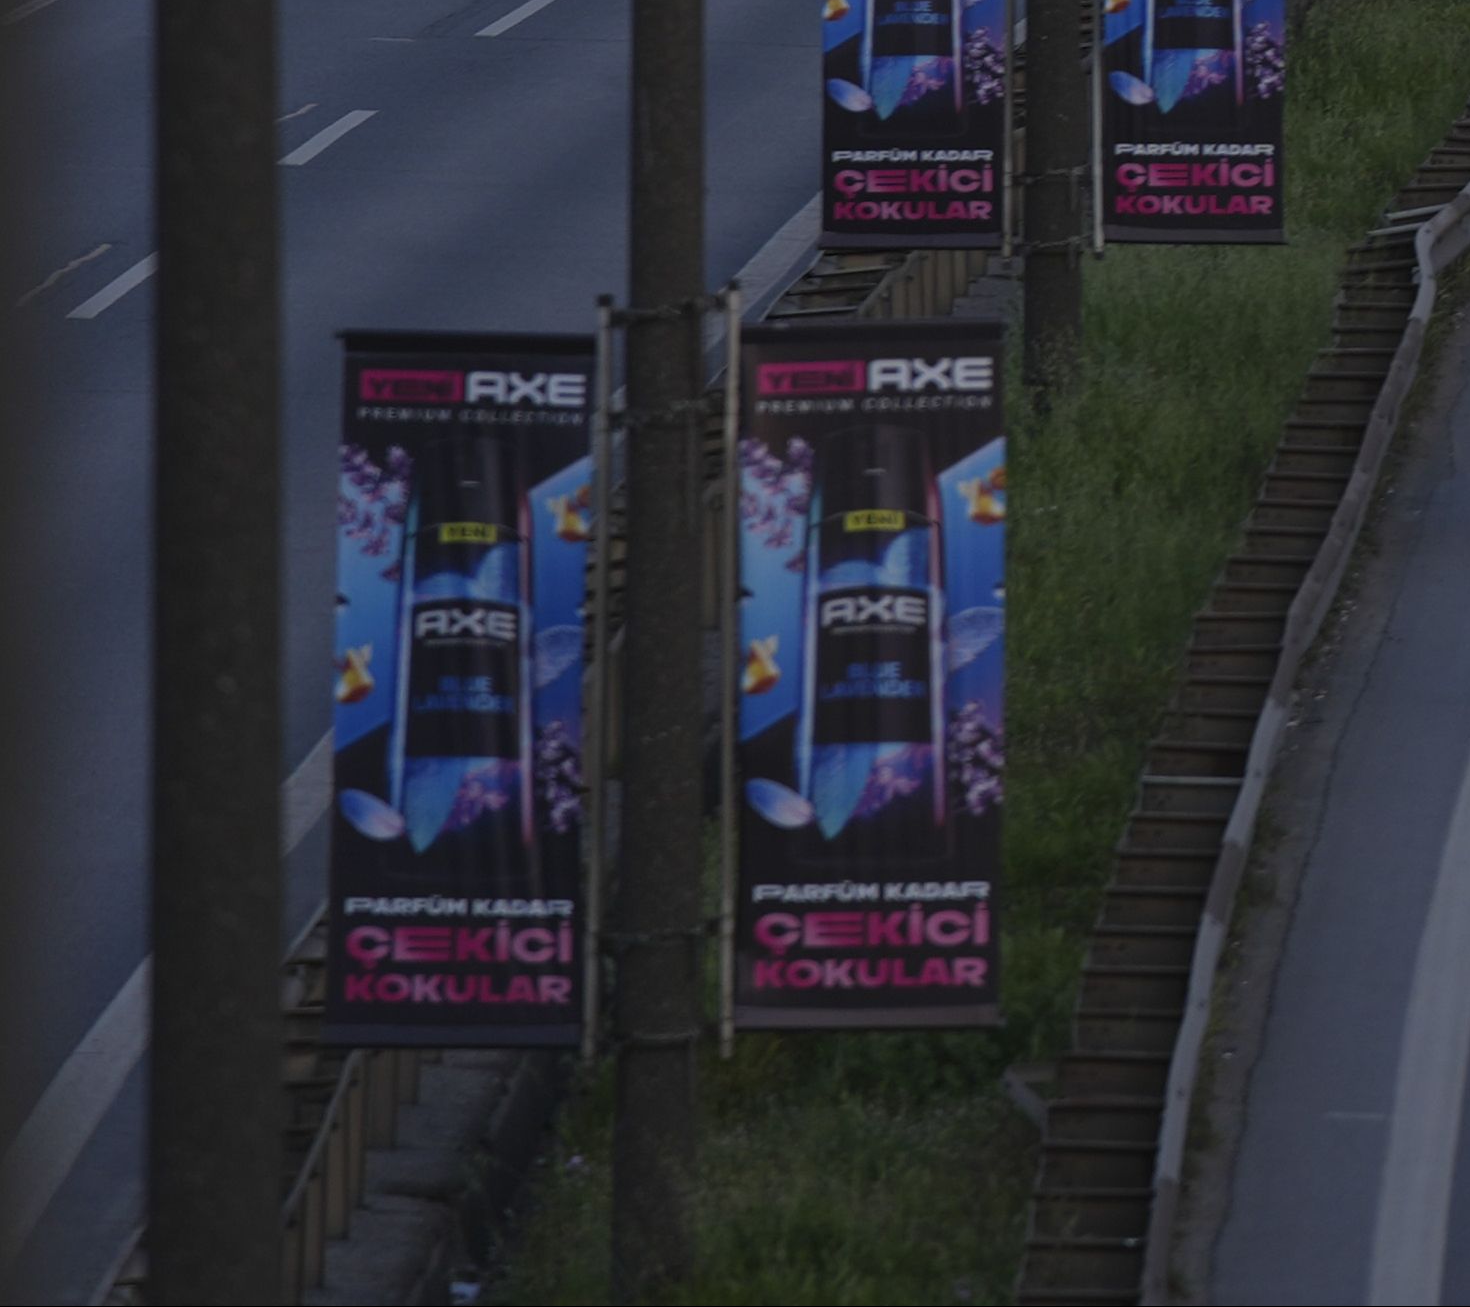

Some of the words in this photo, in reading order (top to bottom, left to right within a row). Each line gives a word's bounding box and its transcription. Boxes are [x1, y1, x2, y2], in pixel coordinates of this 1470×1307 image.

[832, 148, 919, 163] PARFÜM
[921, 149, 995, 163] KADAR
[1114, 141, 1200, 156] PARFÜM
[1201, 142, 1276, 156] KADAR
[834, 164, 995, 199] ÇEKİCİ
[1115, 157, 1275, 193] ÇEKİCİ
[833, 200, 994, 221] KOKULAR
[1114, 194, 1275, 215] KOKULAR
[465, 368, 588, 406] AXE
[865, 355, 994, 393] AXE
[756, 400, 855, 415] PREMIUM
[861, 394, 993, 413] COLLECTION
[415, 605, 517, 638] AXE
[822, 594, 927, 627] AXE
[344, 894, 468, 917] PARFÜM
[472, 897, 575, 917] KADAR
[752, 879, 881, 904] PARFÜM
[883, 879, 992, 901] KADAR
[753, 899, 991, 956] ÇEKİCİ
[344, 919, 574, 970] ÇEKİCİ
[344, 973, 574, 1004] KOKULAR
[752, 955, 990, 990] KOKULAR
